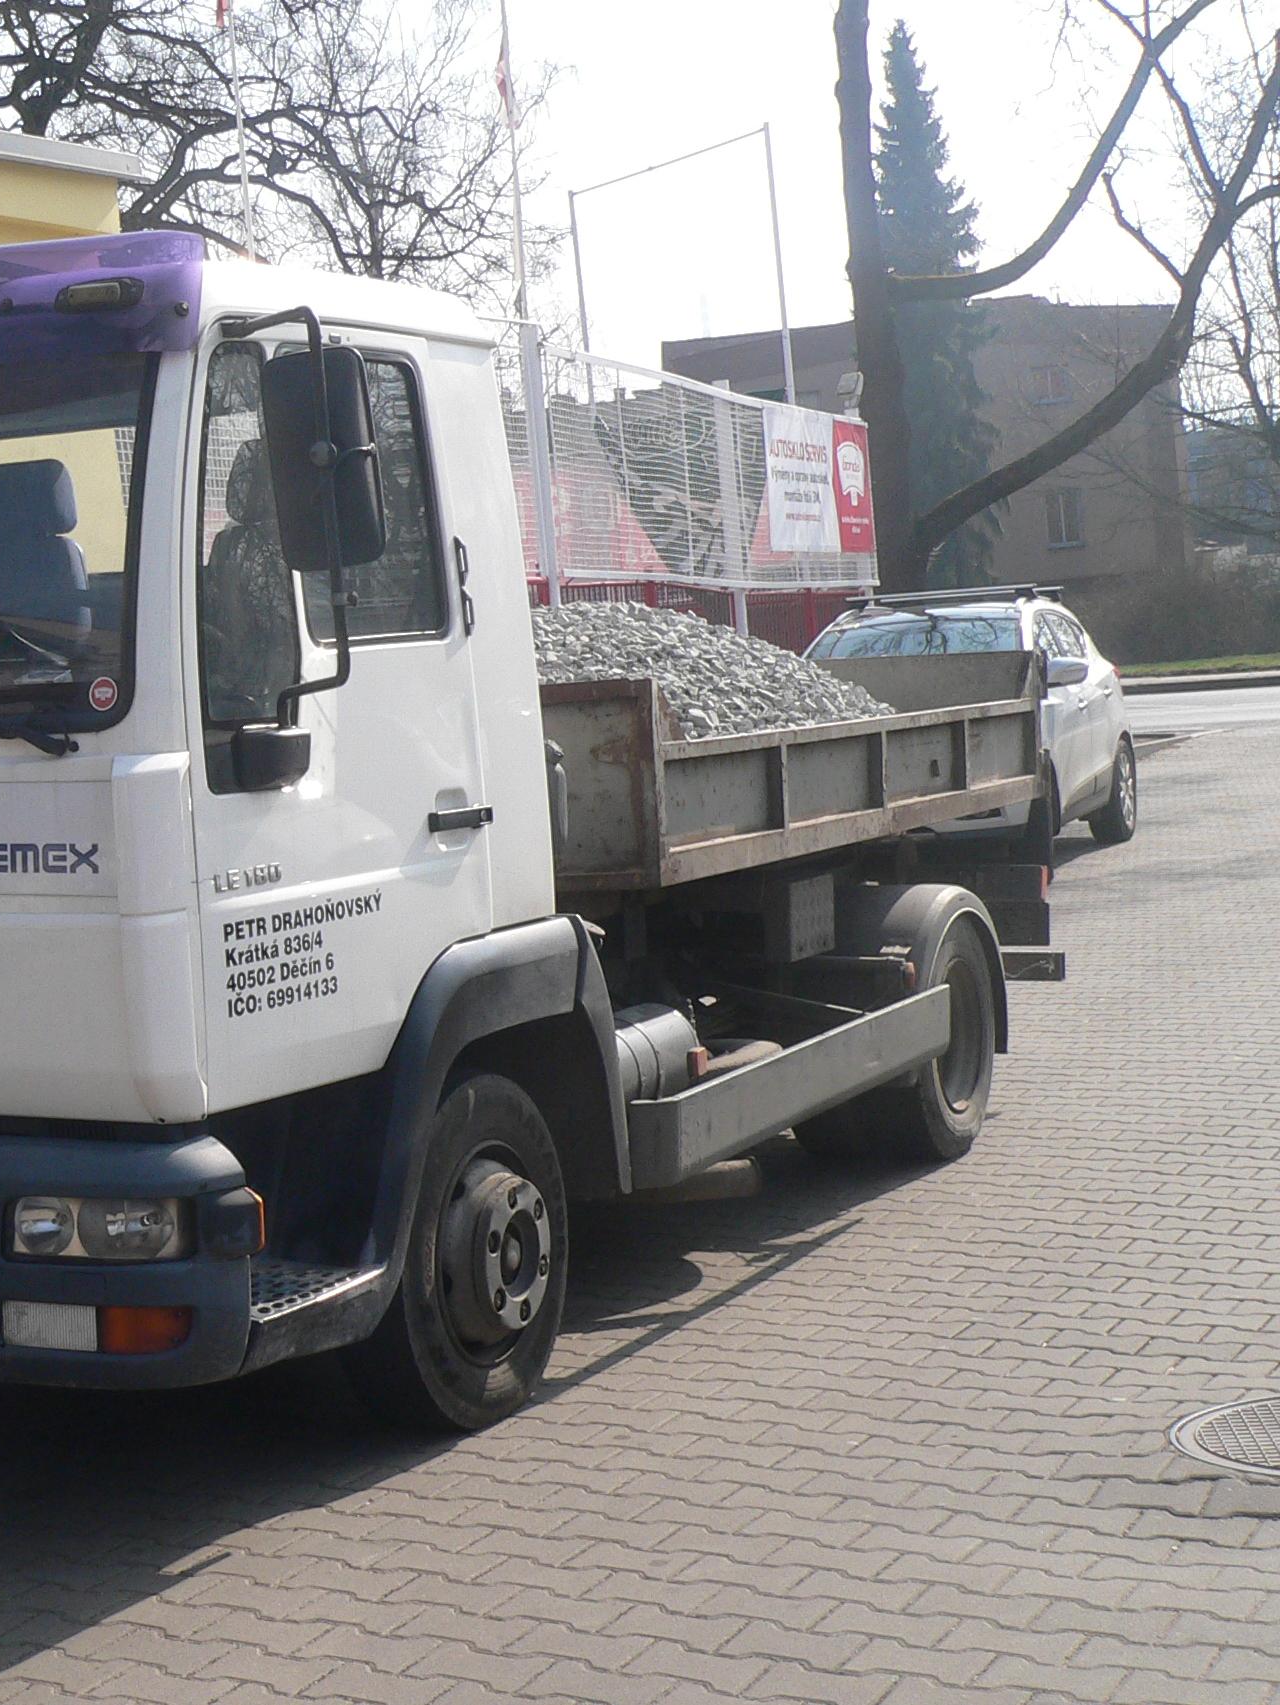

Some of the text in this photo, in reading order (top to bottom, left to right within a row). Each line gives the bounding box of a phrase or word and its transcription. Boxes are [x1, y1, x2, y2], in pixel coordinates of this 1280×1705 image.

[769, 440, 827, 463] AUTOSKLO SERVIS
[214, 869, 240, 893] LE
[223, 888, 382, 942] PETR DRAHOŇOVSKÝ
[225, 931, 323, 967] Krátká 836/4
[226, 953, 334, 993] 40502 Děčín 6
[227, 976, 338, 1018] IČO: 69914133
